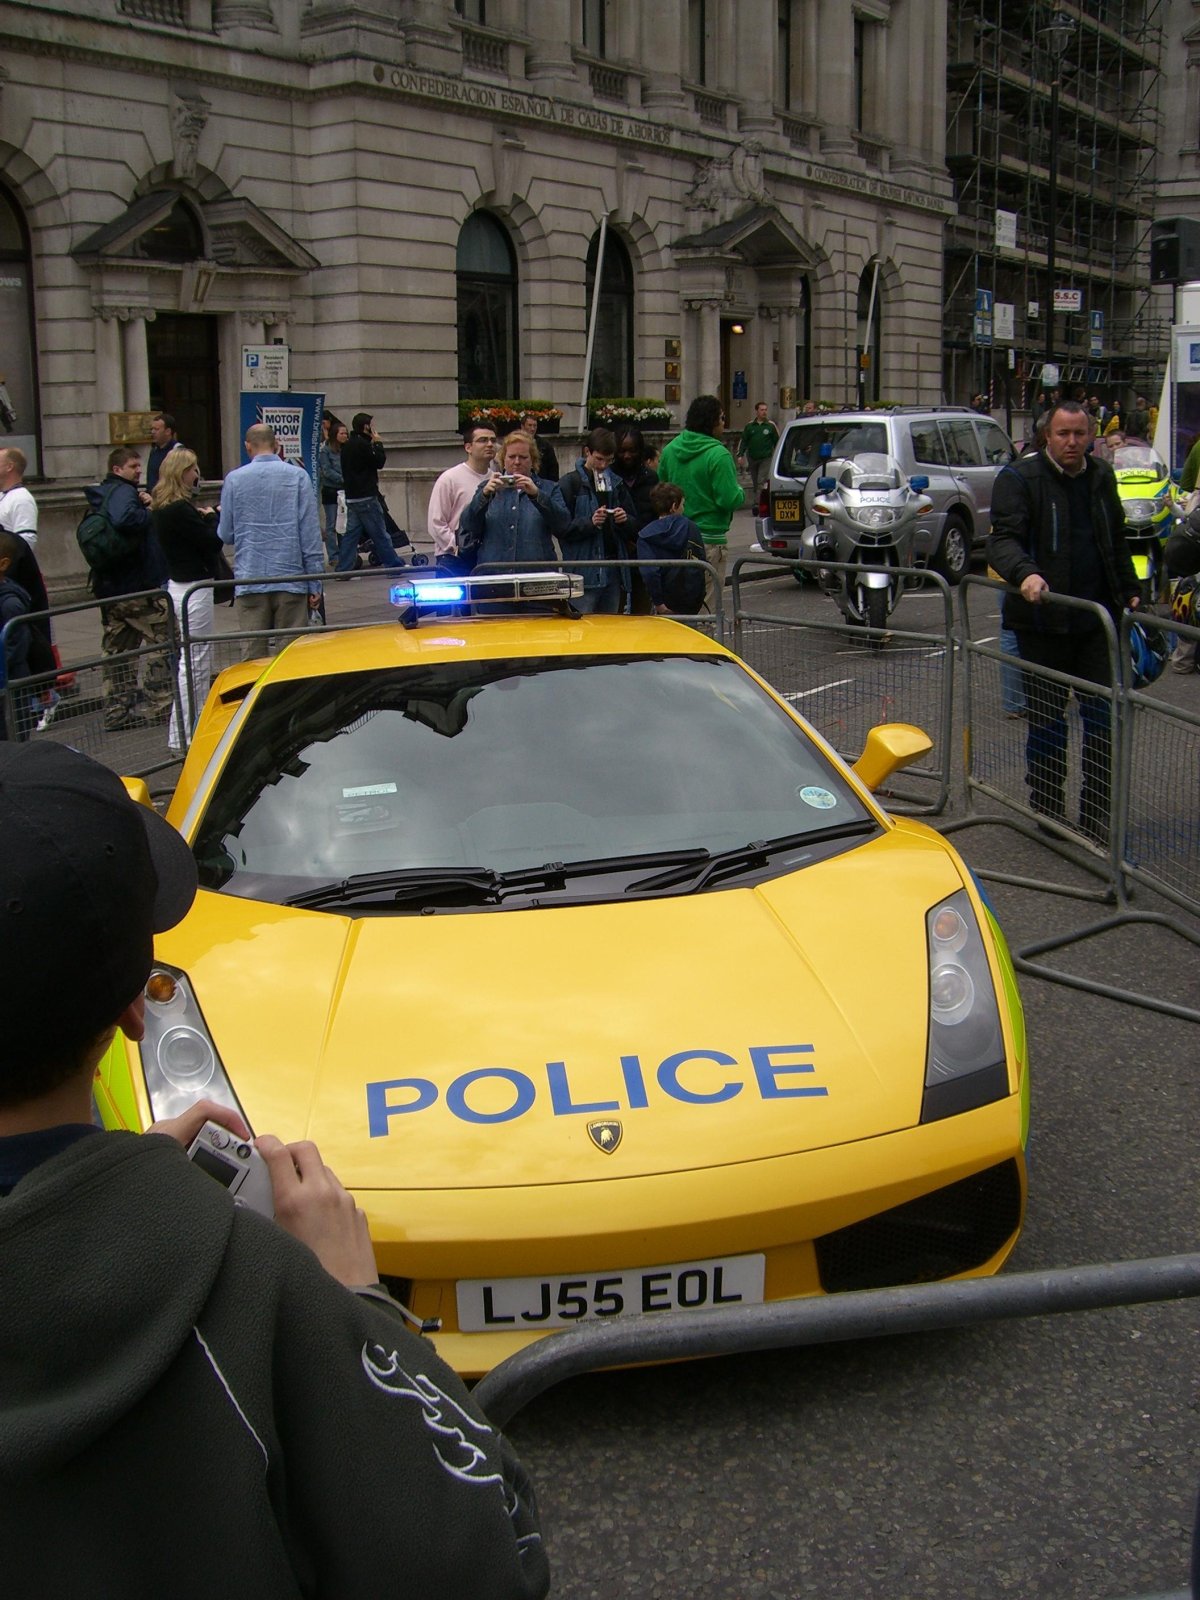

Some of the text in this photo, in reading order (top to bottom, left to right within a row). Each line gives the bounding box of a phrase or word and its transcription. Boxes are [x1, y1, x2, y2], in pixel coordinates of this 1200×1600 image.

[390, 70, 497, 107] CONFEDERACION
[561, 107, 575, 124] DE
[578, 111, 608, 130] CAJAS
[611, 118, 624, 135] DE
[627, 124, 672, 145] AHORROS
[265, 415, 300, 424] MOTOR
[776, 501, 798, 509] LX05
[366, 1043, 829, 1138] POLICE
[482, 1266, 743, 1325] LJ55 EOL
